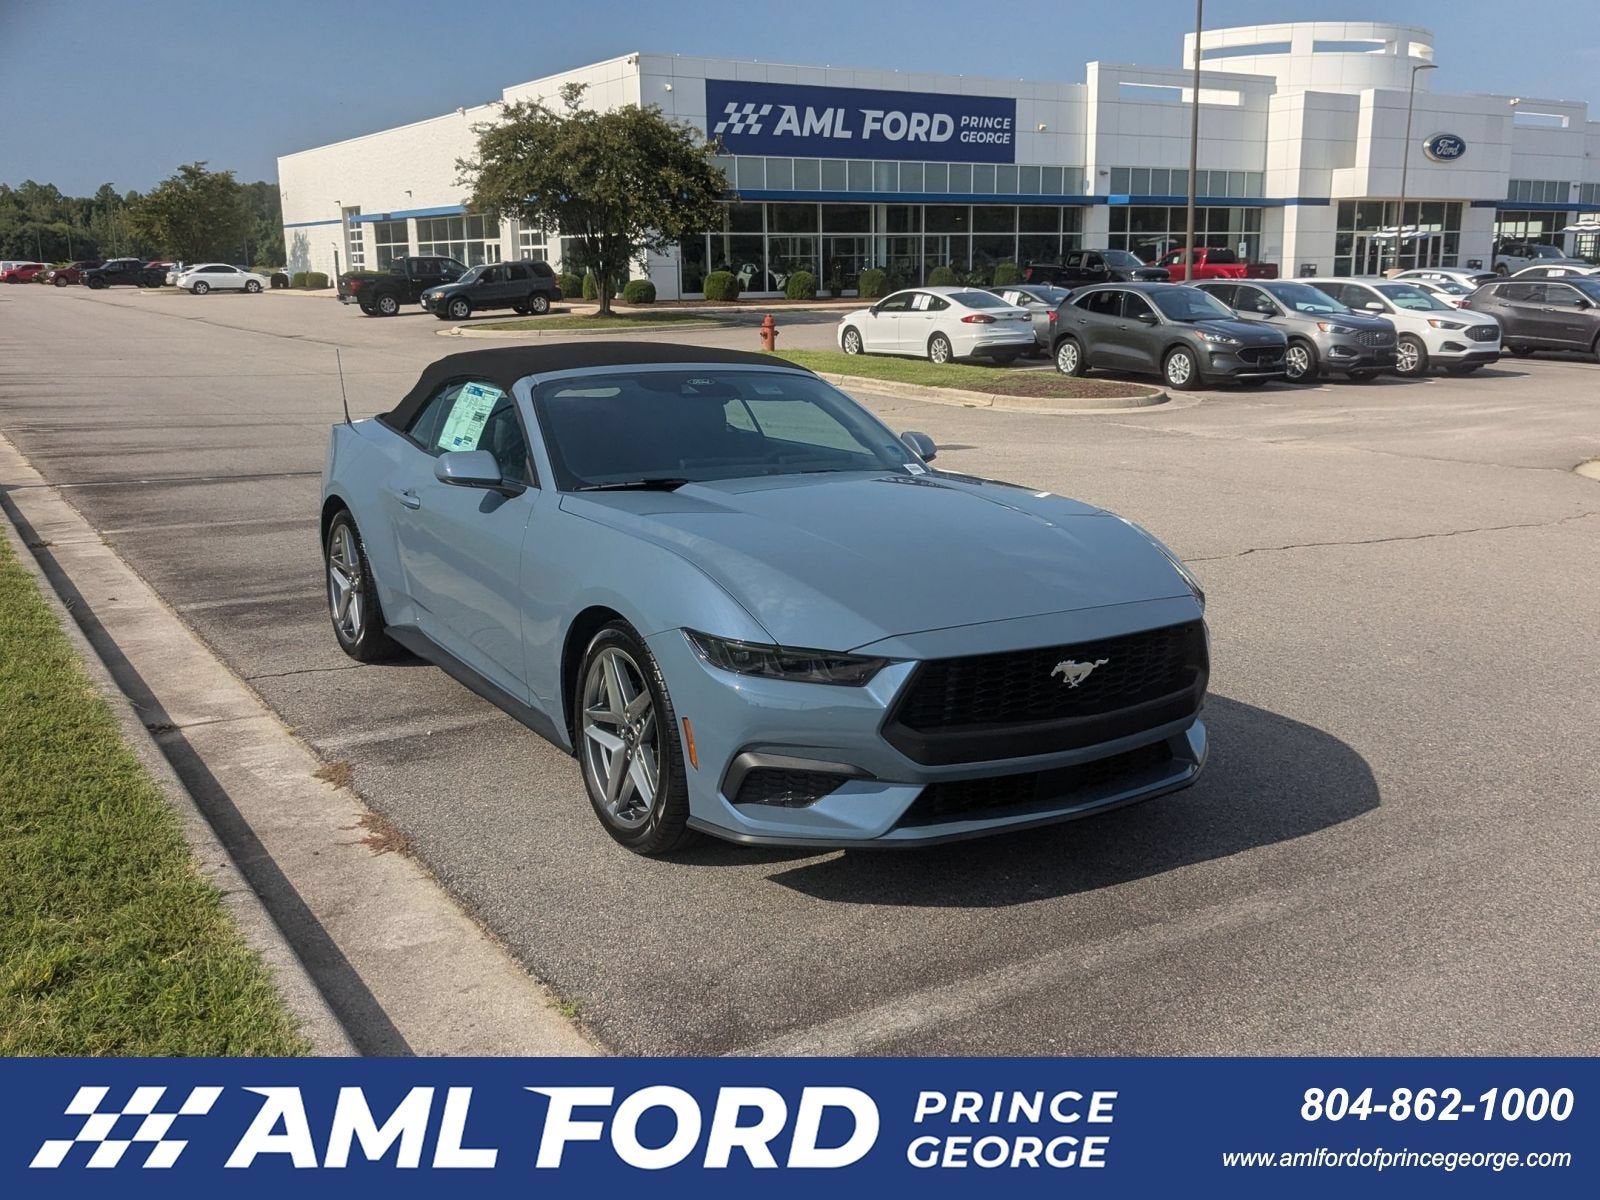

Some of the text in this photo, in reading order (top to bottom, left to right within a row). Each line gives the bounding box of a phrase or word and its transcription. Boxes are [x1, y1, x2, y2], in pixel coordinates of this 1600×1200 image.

[772, 105, 955, 142] AML FORD
[960, 115, 1011, 129] PRINCE
[960, 131, 1011, 144] GEORGE
[1436, 139, 1460, 155] Ford
